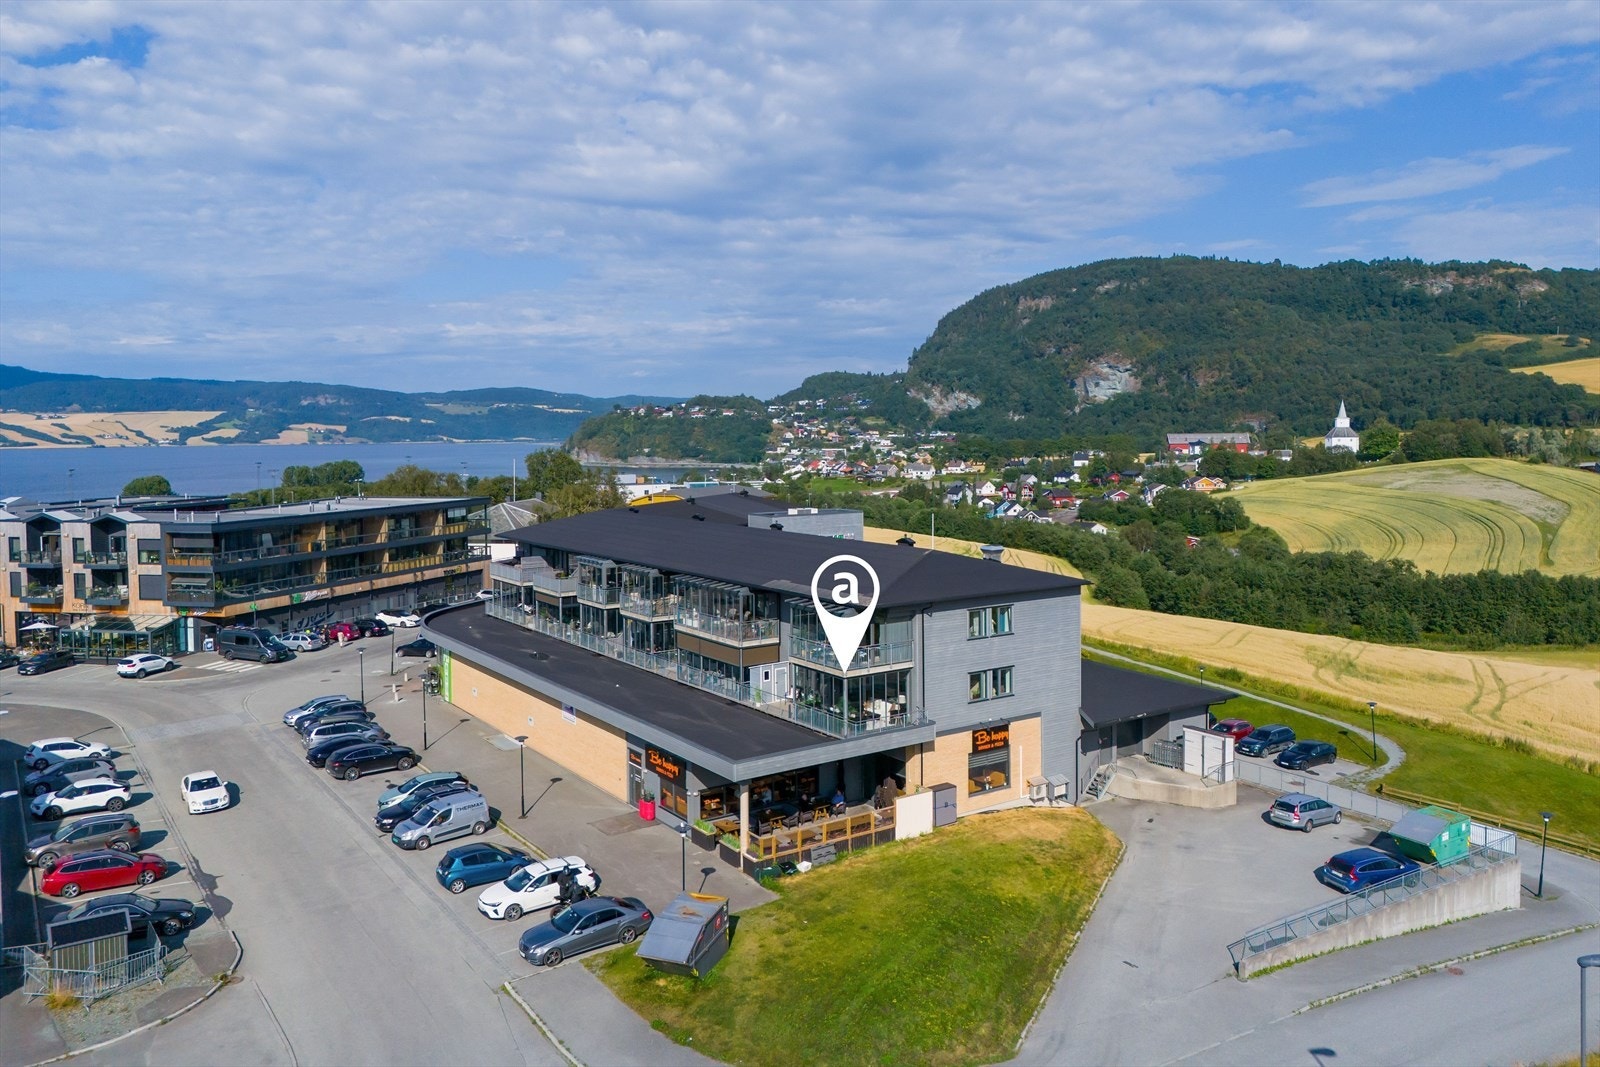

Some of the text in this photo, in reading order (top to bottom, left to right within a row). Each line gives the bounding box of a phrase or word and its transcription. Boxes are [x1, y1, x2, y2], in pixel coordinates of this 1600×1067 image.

[975, 731, 1009, 745] Be happy
[648, 750, 662, 766] Be
[662, 757, 679, 777] happy
